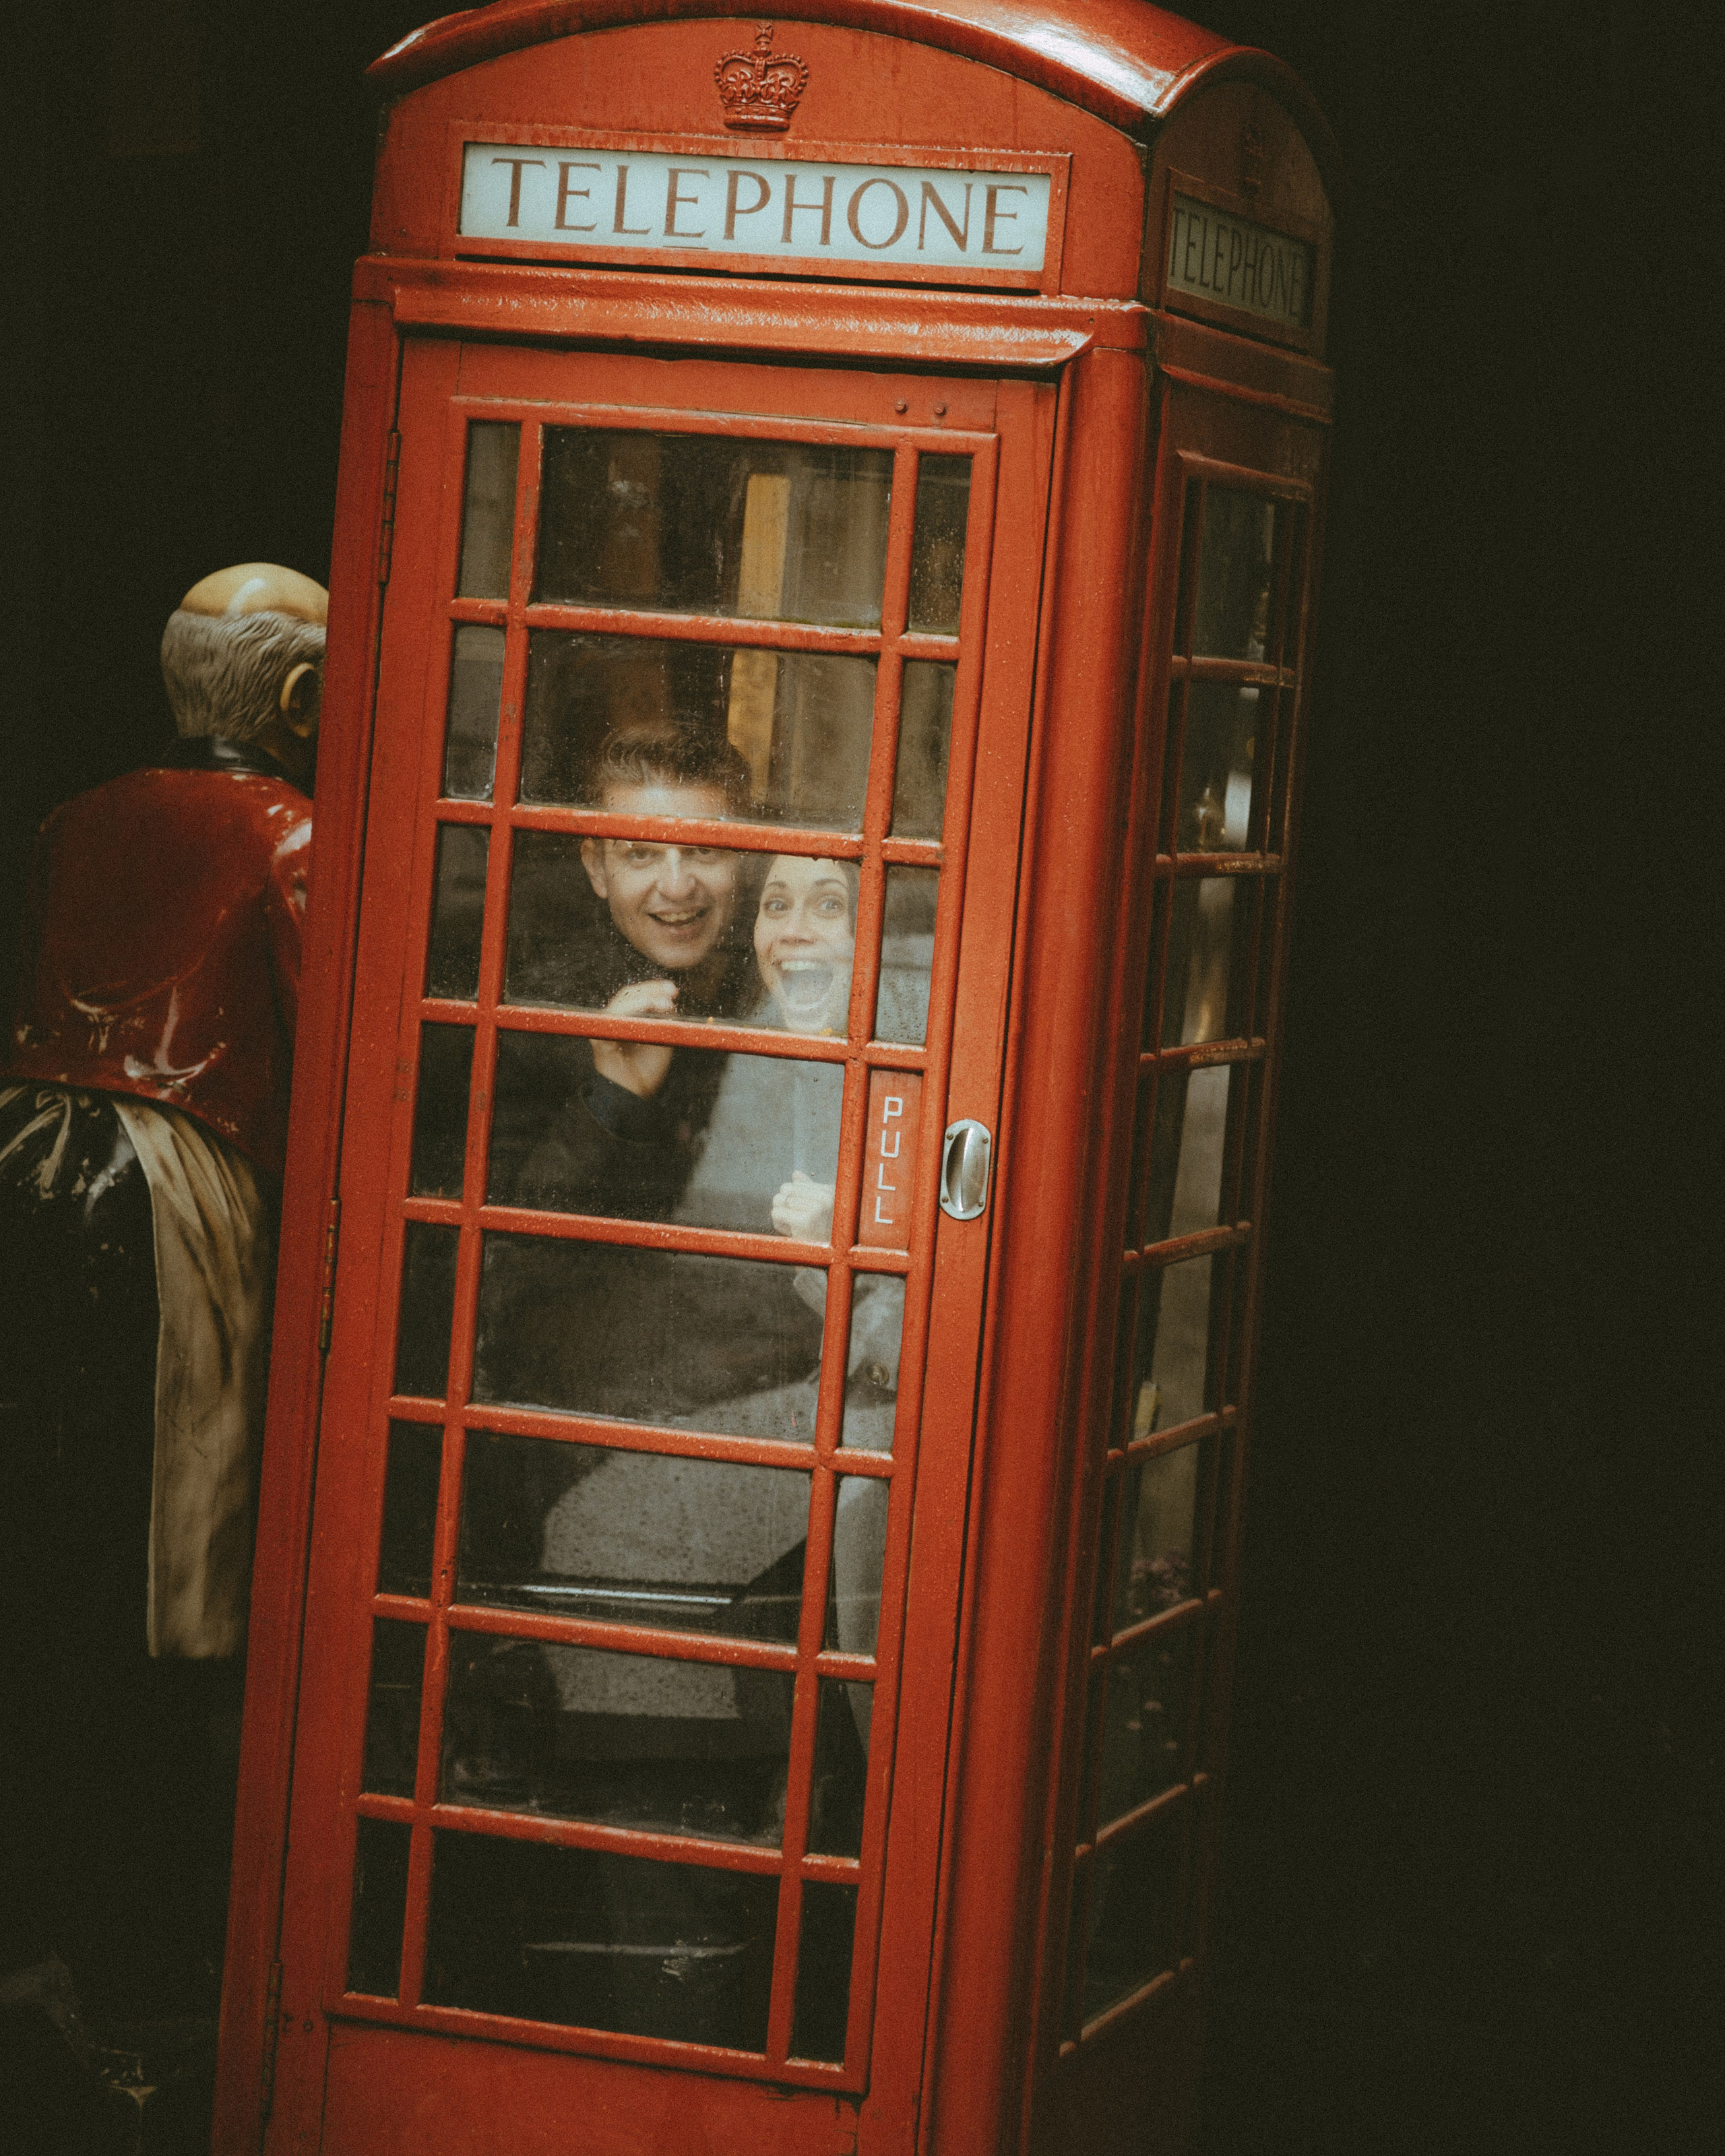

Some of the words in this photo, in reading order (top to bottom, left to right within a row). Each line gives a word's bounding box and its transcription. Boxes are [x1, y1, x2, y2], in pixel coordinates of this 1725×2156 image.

[491, 157, 1029, 255] TELEPHONE
[1170, 208, 1301, 317] TELEPHONE
[875, 1096, 903, 1224] PULL
